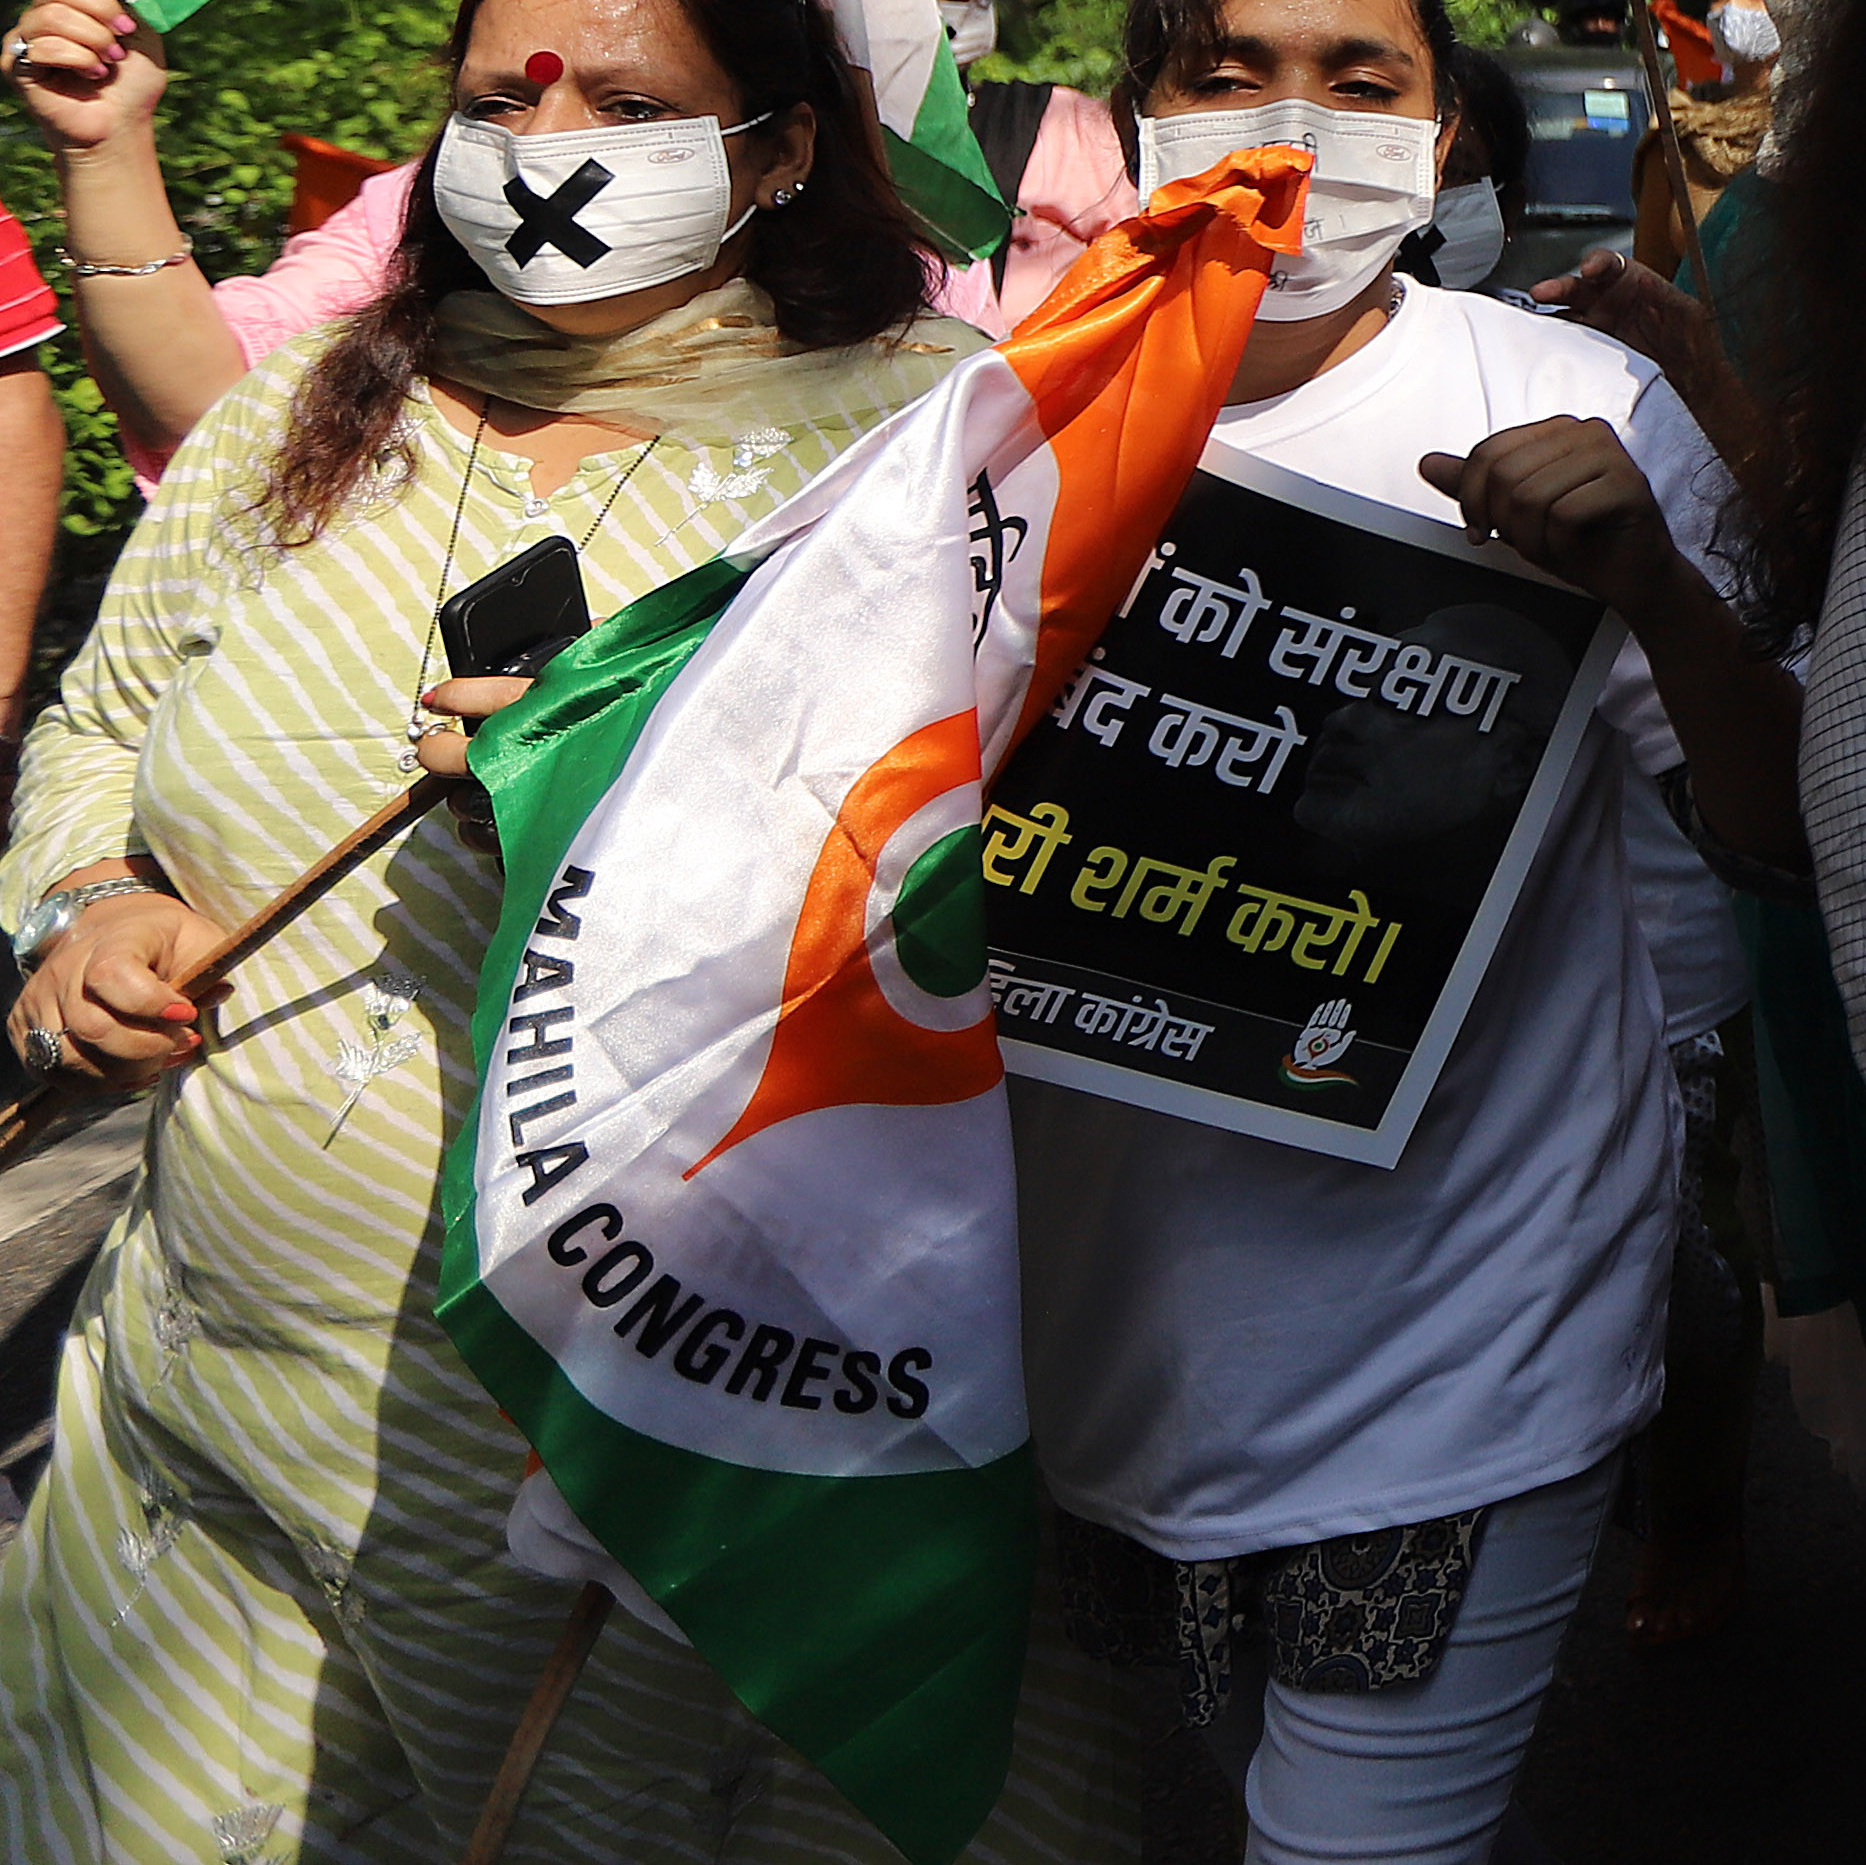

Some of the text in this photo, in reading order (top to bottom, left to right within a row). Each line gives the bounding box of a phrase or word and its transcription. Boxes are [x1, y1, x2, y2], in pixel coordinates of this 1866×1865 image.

[1159, 567, 1273, 660] को
[1267, 604, 1523, 735] संरक्षण
[1147, 691, 1308, 797] करो
[1068, 843, 1237, 939] शर्म
[1224, 881, 1404, 987] करो।
[1072, 988, 1216, 1064] कांग्रेस
[505, 863, 933, 1422] MAHILA CONGRESS
